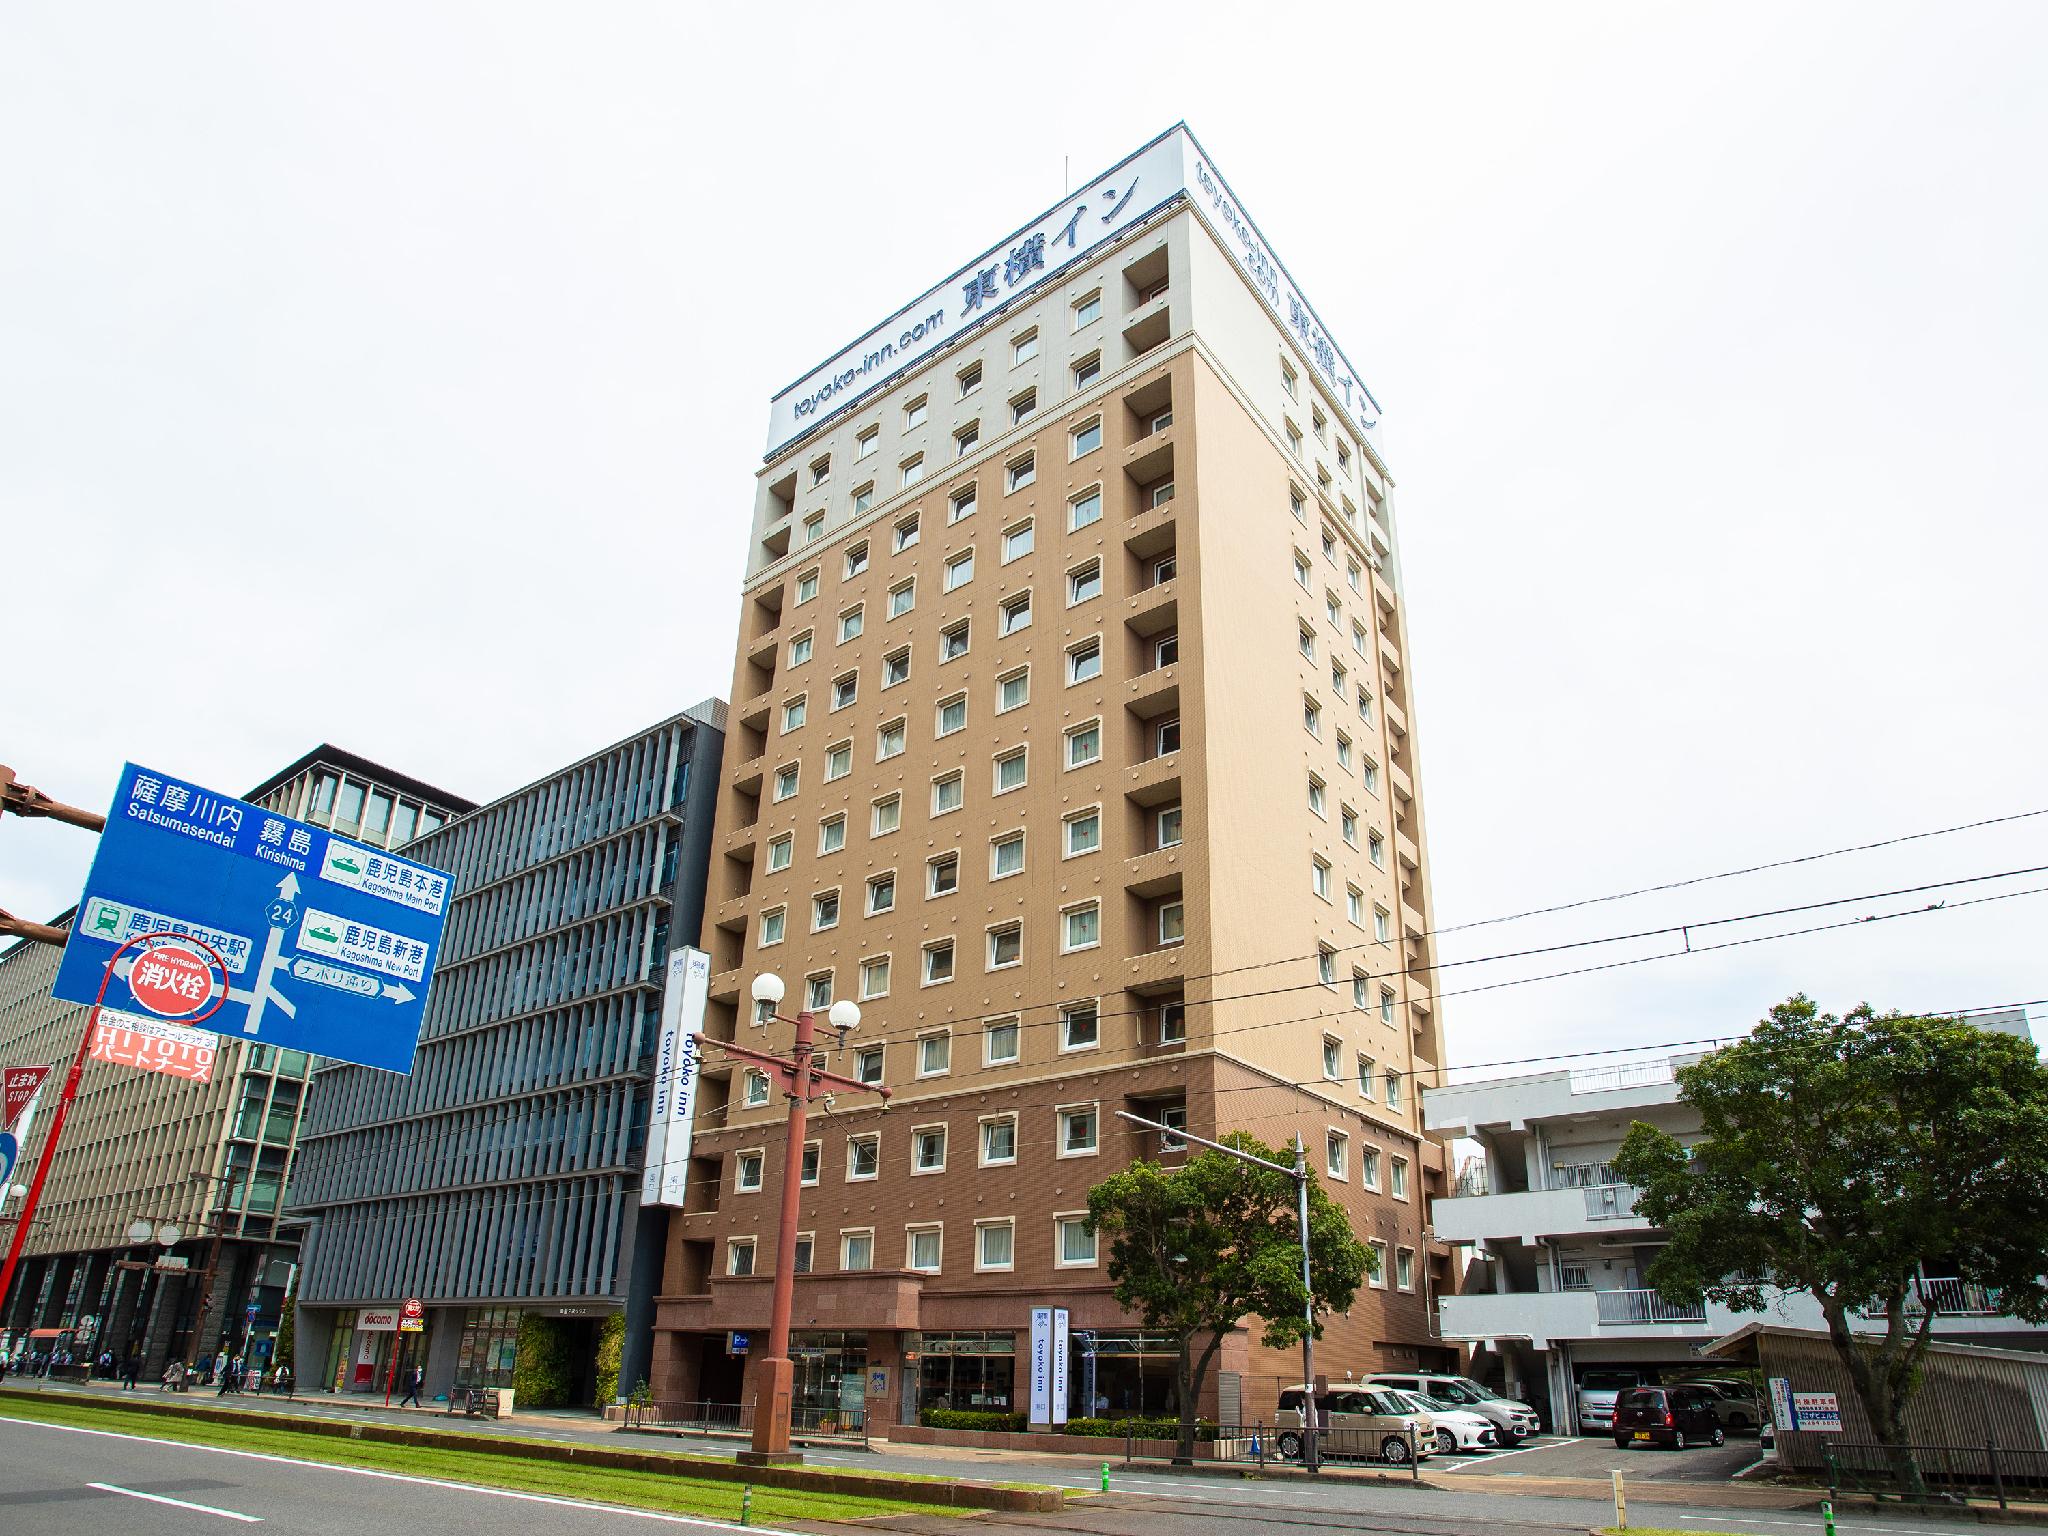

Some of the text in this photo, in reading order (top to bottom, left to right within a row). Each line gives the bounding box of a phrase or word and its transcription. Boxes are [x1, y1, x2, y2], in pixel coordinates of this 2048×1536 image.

[794, 176, 1139, 419] toyoko-inn.com 東横イン
[131, 774, 312, 856] 薩摩川内 霧島
[127, 802, 306, 871] Satsumasendai Kirishima
[362, 878, 439, 912] Kagoshima Main Port
[365, 857, 444, 900] 鹿児島本港
[271, 904, 293, 924] 24
[128, 912, 247, 958] 鹿児島中央駅
[344, 925, 424, 965] 鹿児島新港
[153, 952, 204, 971] FIRE HYDRANT
[222, 956, 241, 970] Sta.
[340, 947, 420, 978] Kagoshima New Port
[137, 960, 205, 1000] 消火栓
[97, 1026, 213, 1064] HITOTO
[8, 1072, 37, 1088] 止まれ
[657, 1030, 674, 1114] toyoko inn
[8, 1091, 29, 1102] STOP
[678, 1091, 690, 1115] inn
[364, 1314, 392, 1325] docomo
[734, 1335, 741, 1345] P
[1037, 1338, 1045, 1391] toyoko inn
